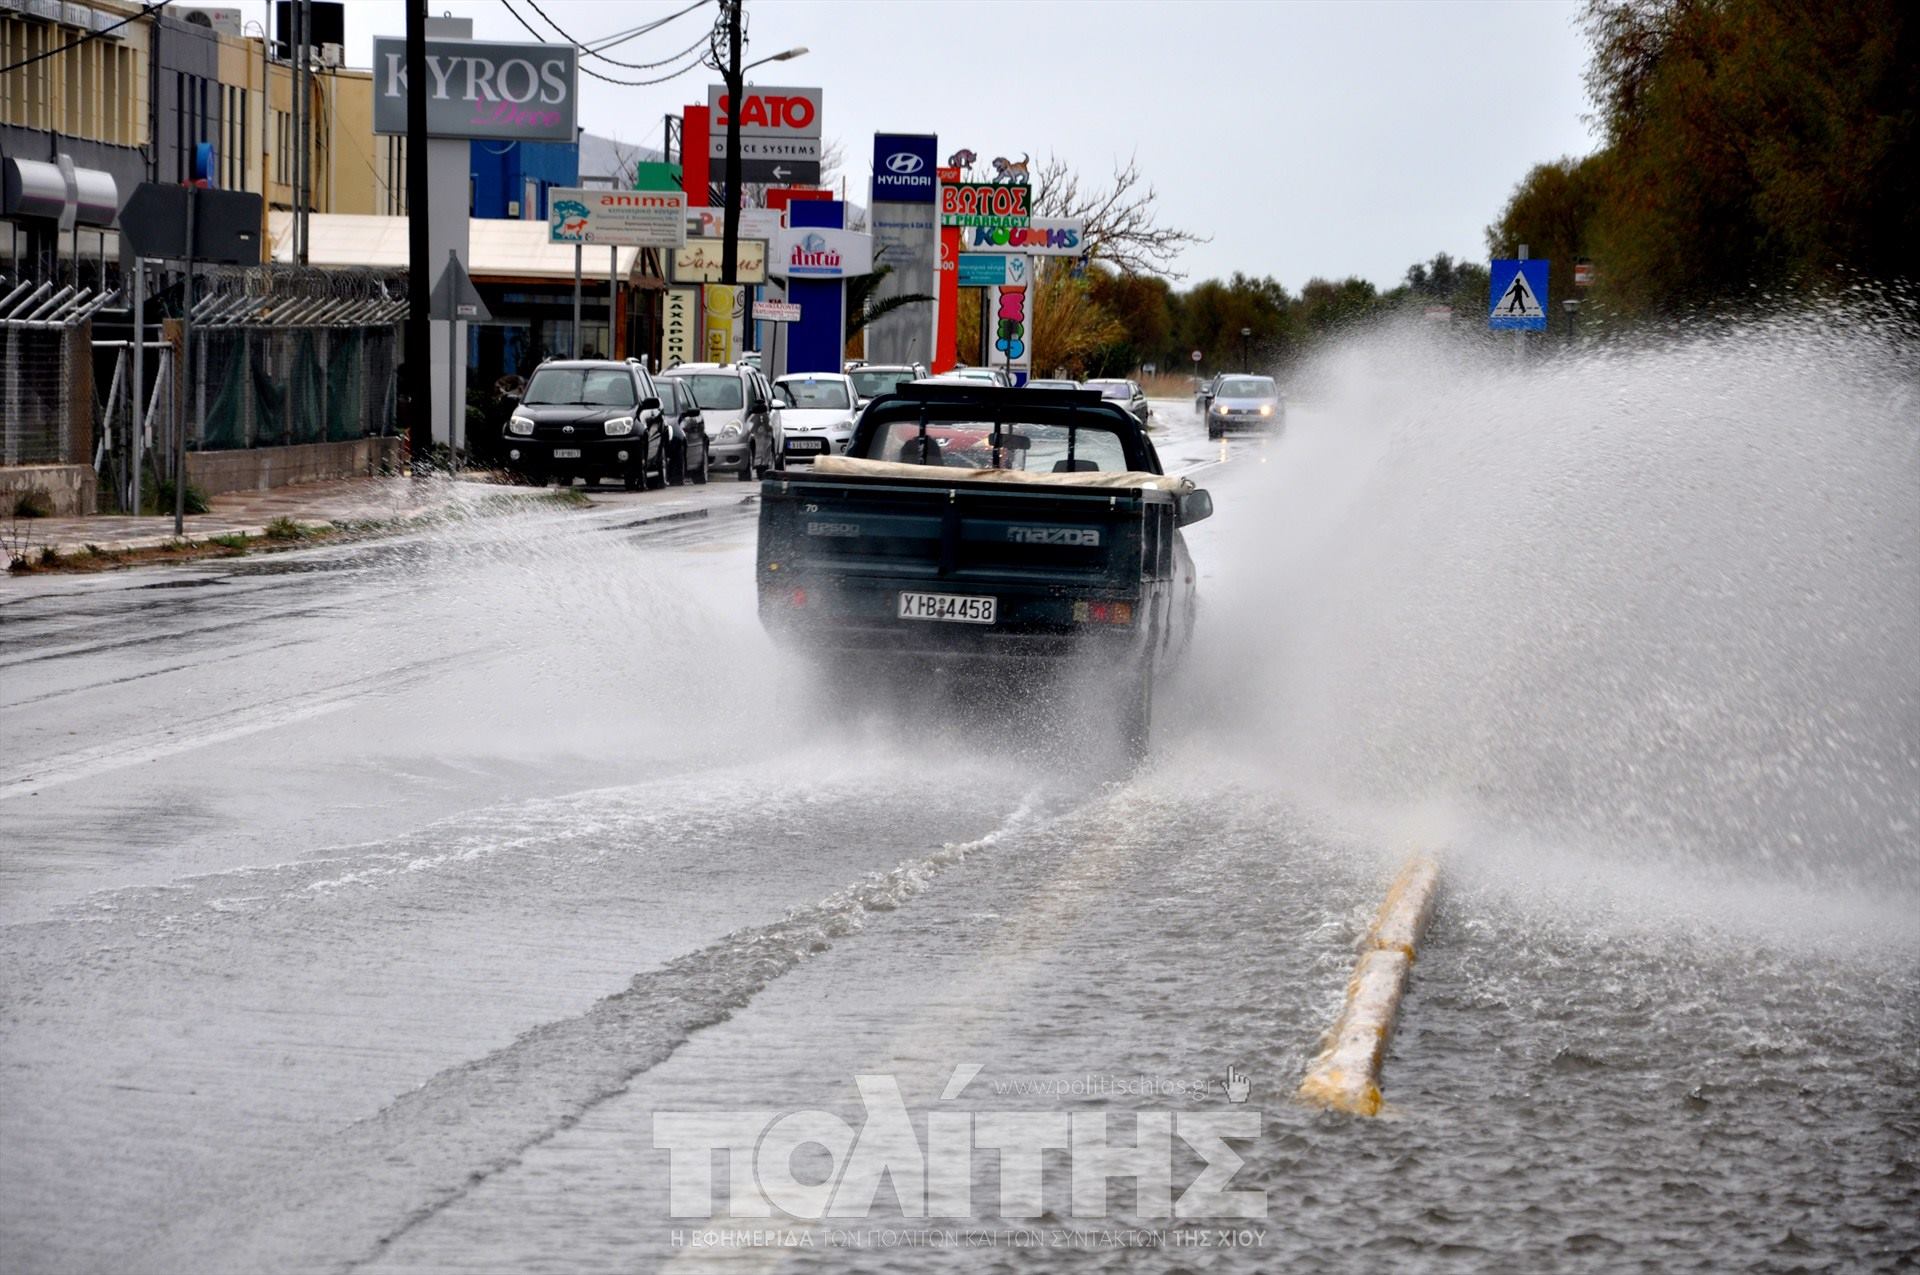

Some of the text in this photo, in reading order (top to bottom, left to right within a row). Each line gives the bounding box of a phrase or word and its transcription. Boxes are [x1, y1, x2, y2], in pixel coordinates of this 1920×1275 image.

[385, 53, 567, 104] KYROS
[717, 95, 814, 128] SATO
[716, 144, 815, 155] OCE SYSTEMS
[877, 175, 931, 186] HYUNDAI
[600, 195, 680, 208] anima
[955, 215, 1026, 228] PHARMACY
[805, 504, 818, 513] 70
[946, 598, 992, 619] 4458
